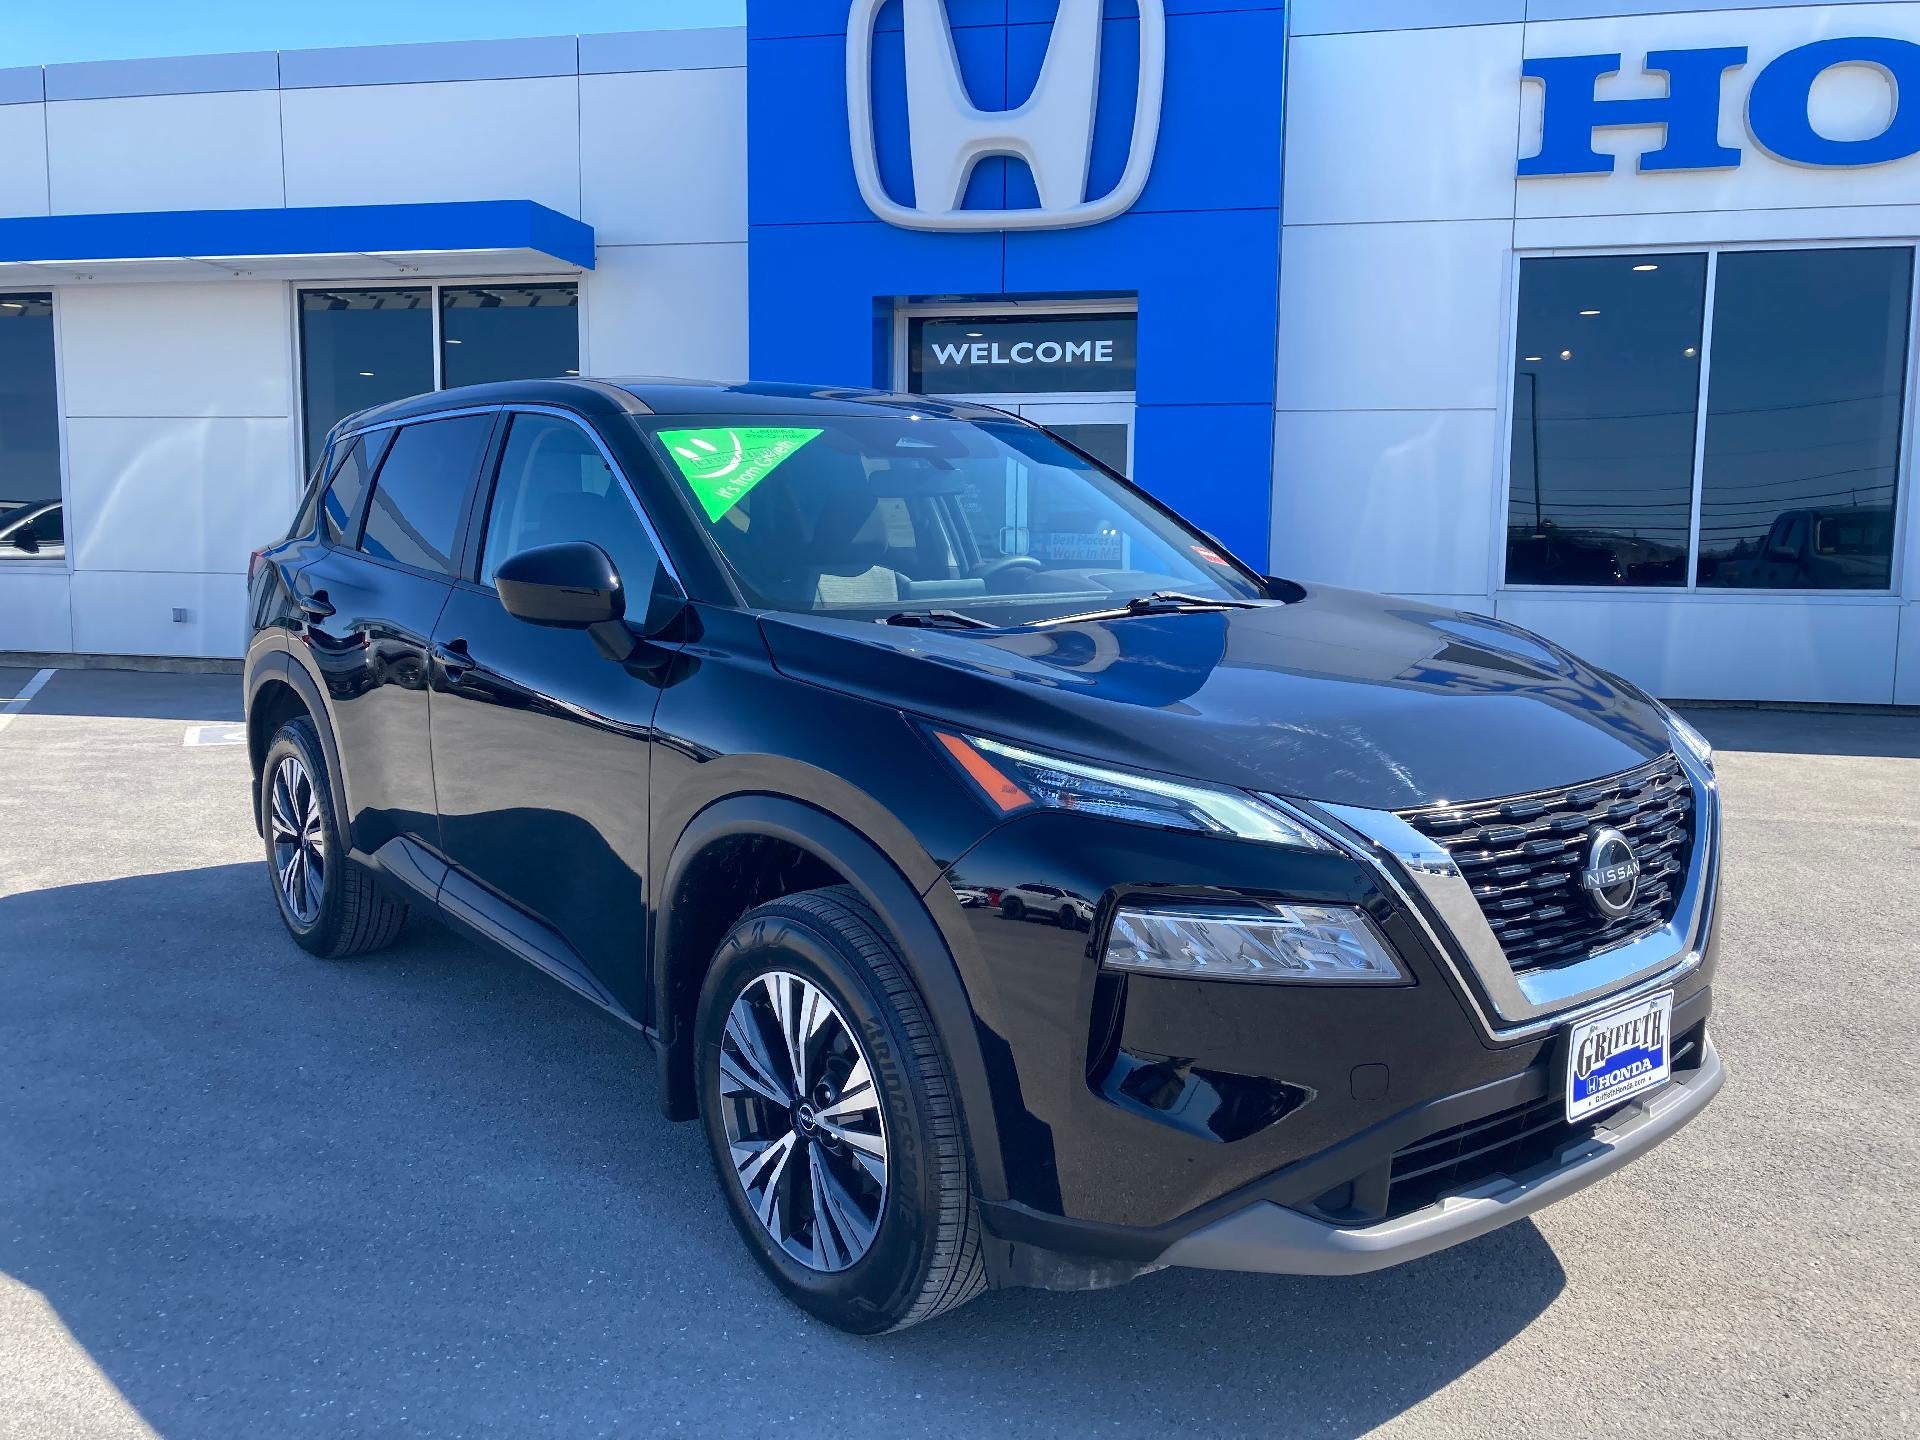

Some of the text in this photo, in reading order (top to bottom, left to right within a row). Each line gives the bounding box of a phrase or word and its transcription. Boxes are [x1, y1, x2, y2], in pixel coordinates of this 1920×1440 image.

[1516, 36, 1920, 177] HO
[931, 340, 1113, 365] WELCOME
[1587, 860, 1640, 886] NISSAN
[1576, 1009, 1664, 1078] GRIFFETH
[1598, 1057, 1653, 1090] HONDA
